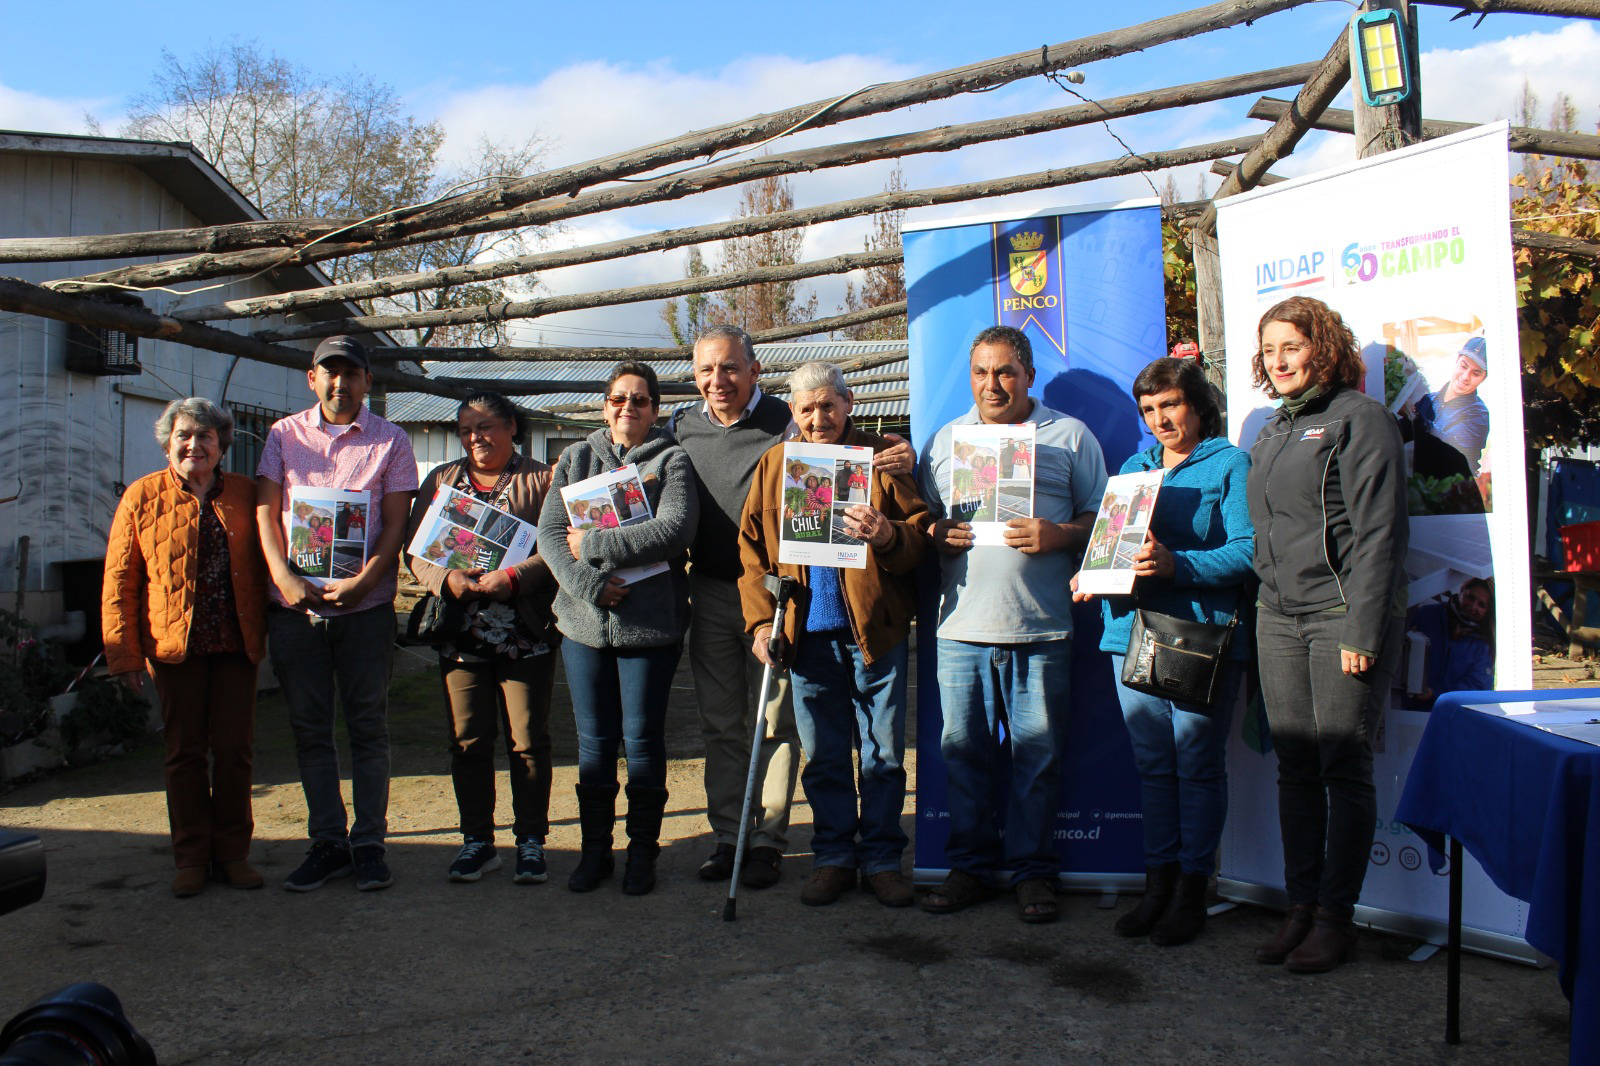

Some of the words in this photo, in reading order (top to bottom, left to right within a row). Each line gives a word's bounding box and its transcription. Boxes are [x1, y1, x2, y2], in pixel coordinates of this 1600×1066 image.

[1381, 229, 1449, 251] TRANSFORMANDO
[1451, 226, 1461, 237] EL
[1341, 242, 1379, 282] 60
[1381, 237, 1465, 278] CAMPO
[1256, 251, 1325, 286] INDAP
[1003, 295, 1058, 312] PENCO
[959, 494, 988, 514] CHILE
[791, 516, 821, 532] CHILE
[795, 530, 822, 539] RURAL
[296, 552, 323, 568] CHILE
[475, 548, 493, 574] HILE
[837, 551, 858, 559] INDAP
[1090, 542, 1111, 562] CHILE
